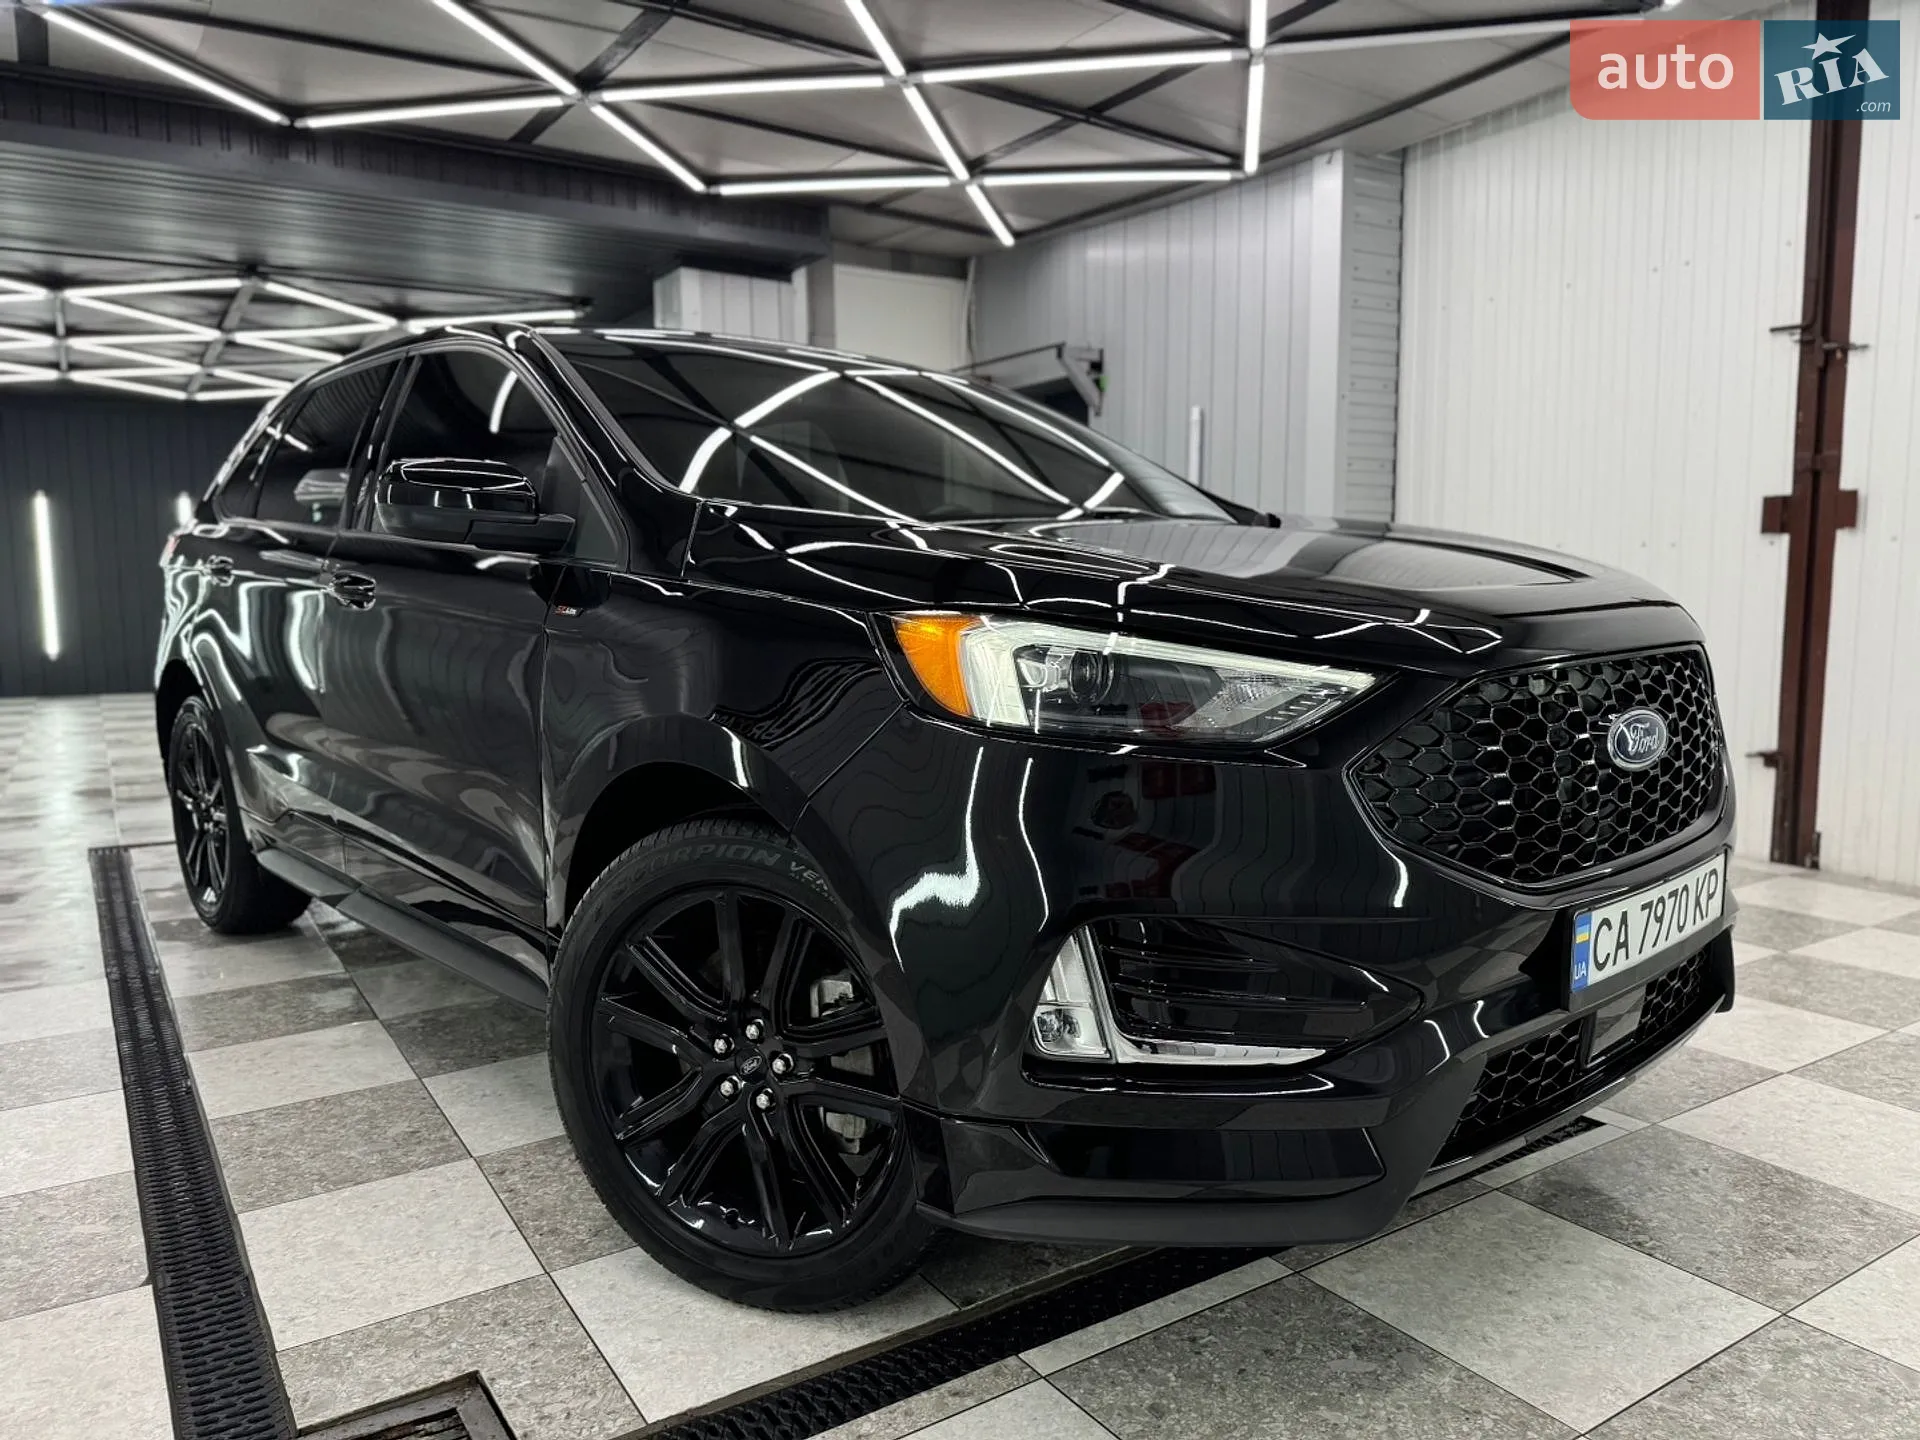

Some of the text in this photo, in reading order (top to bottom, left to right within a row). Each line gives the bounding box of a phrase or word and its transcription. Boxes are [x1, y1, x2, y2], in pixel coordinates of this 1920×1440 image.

[1626, 722, 1660, 755] Ford
[1593, 868, 1719, 972] CA 7970 KP
[1574, 962, 1587, 980] UA
